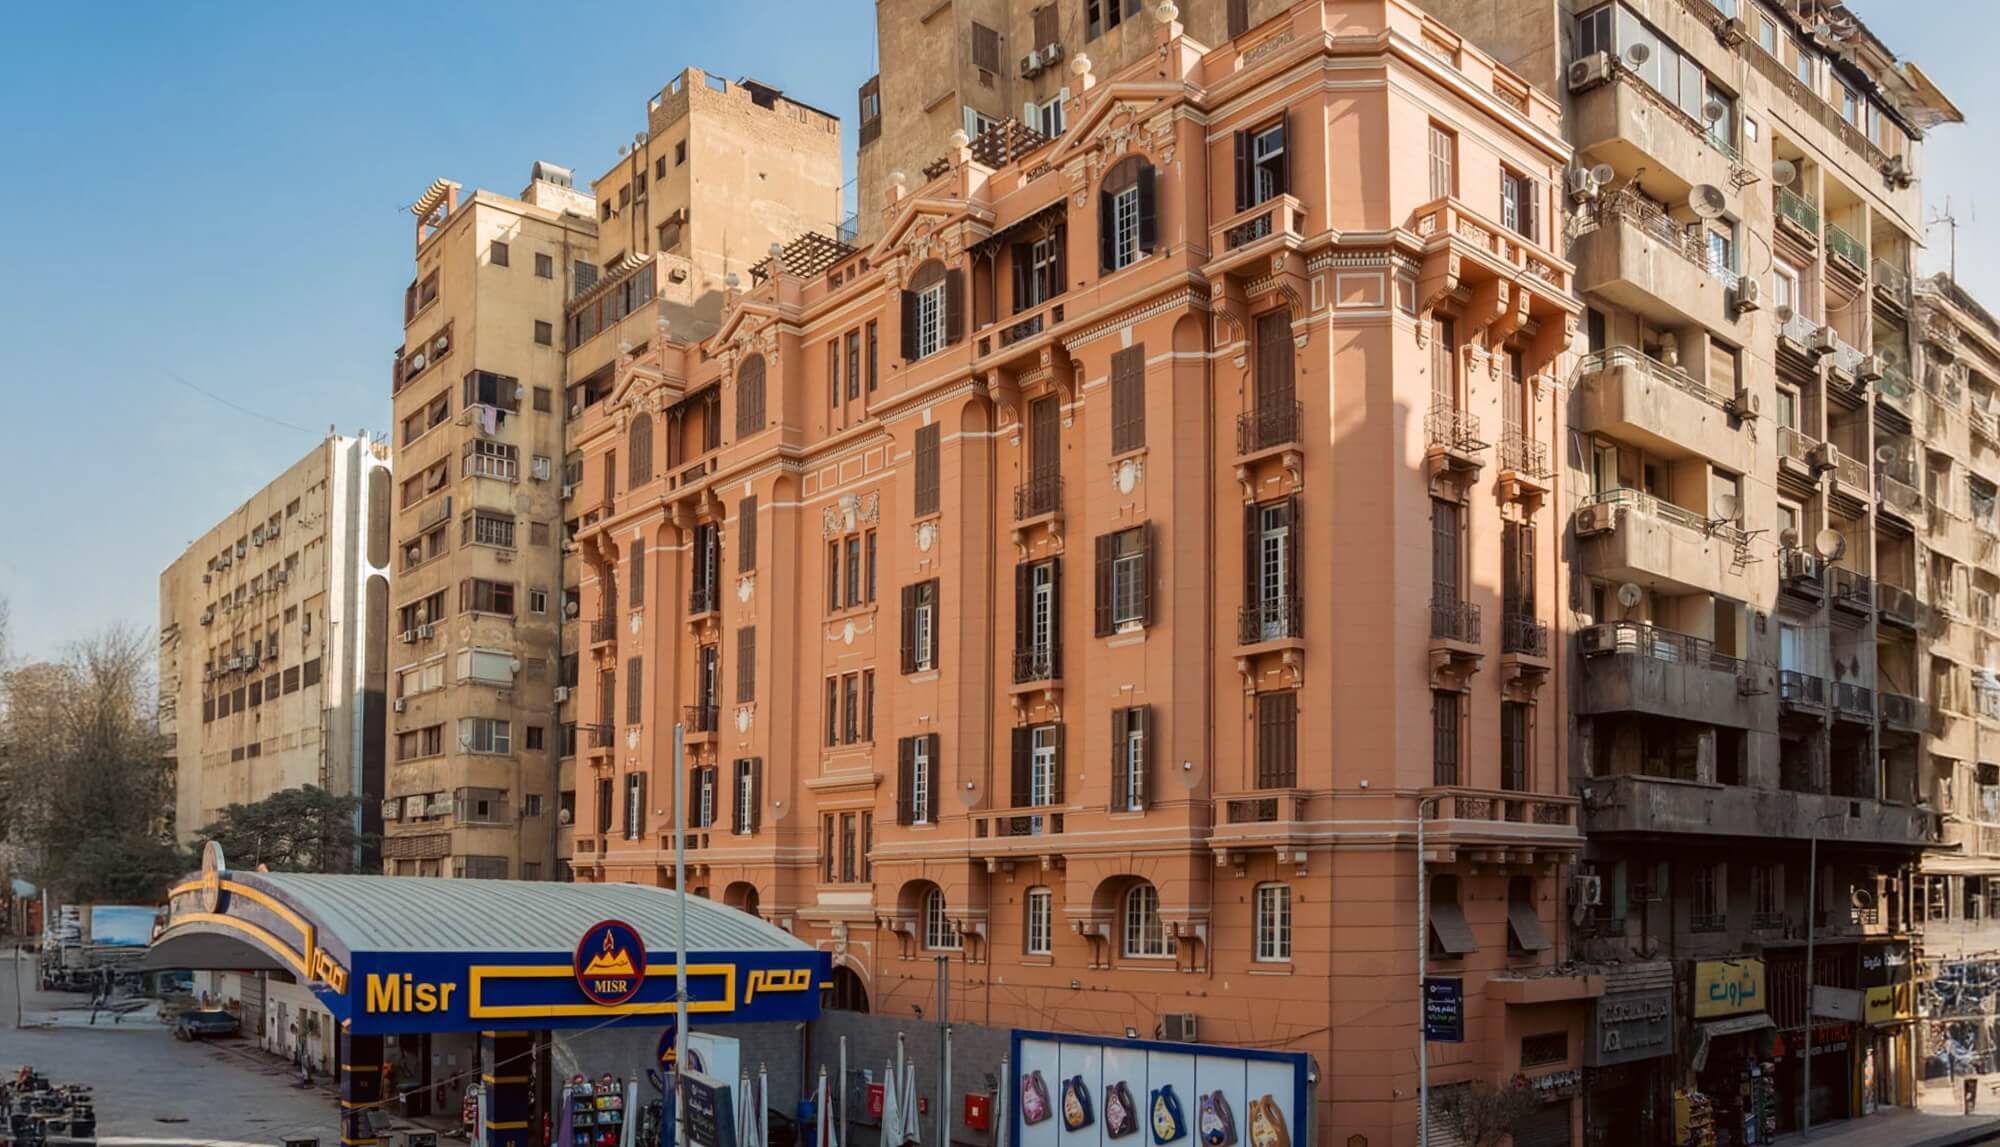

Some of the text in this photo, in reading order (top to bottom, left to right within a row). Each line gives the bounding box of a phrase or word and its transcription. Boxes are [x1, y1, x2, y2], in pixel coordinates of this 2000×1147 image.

[366, 973, 457, 1013] Misr
[594, 979, 628, 993] MISR
[744, 969, 811, 1005] مصر
[1710, 965, 1755, 1006] ثروت
